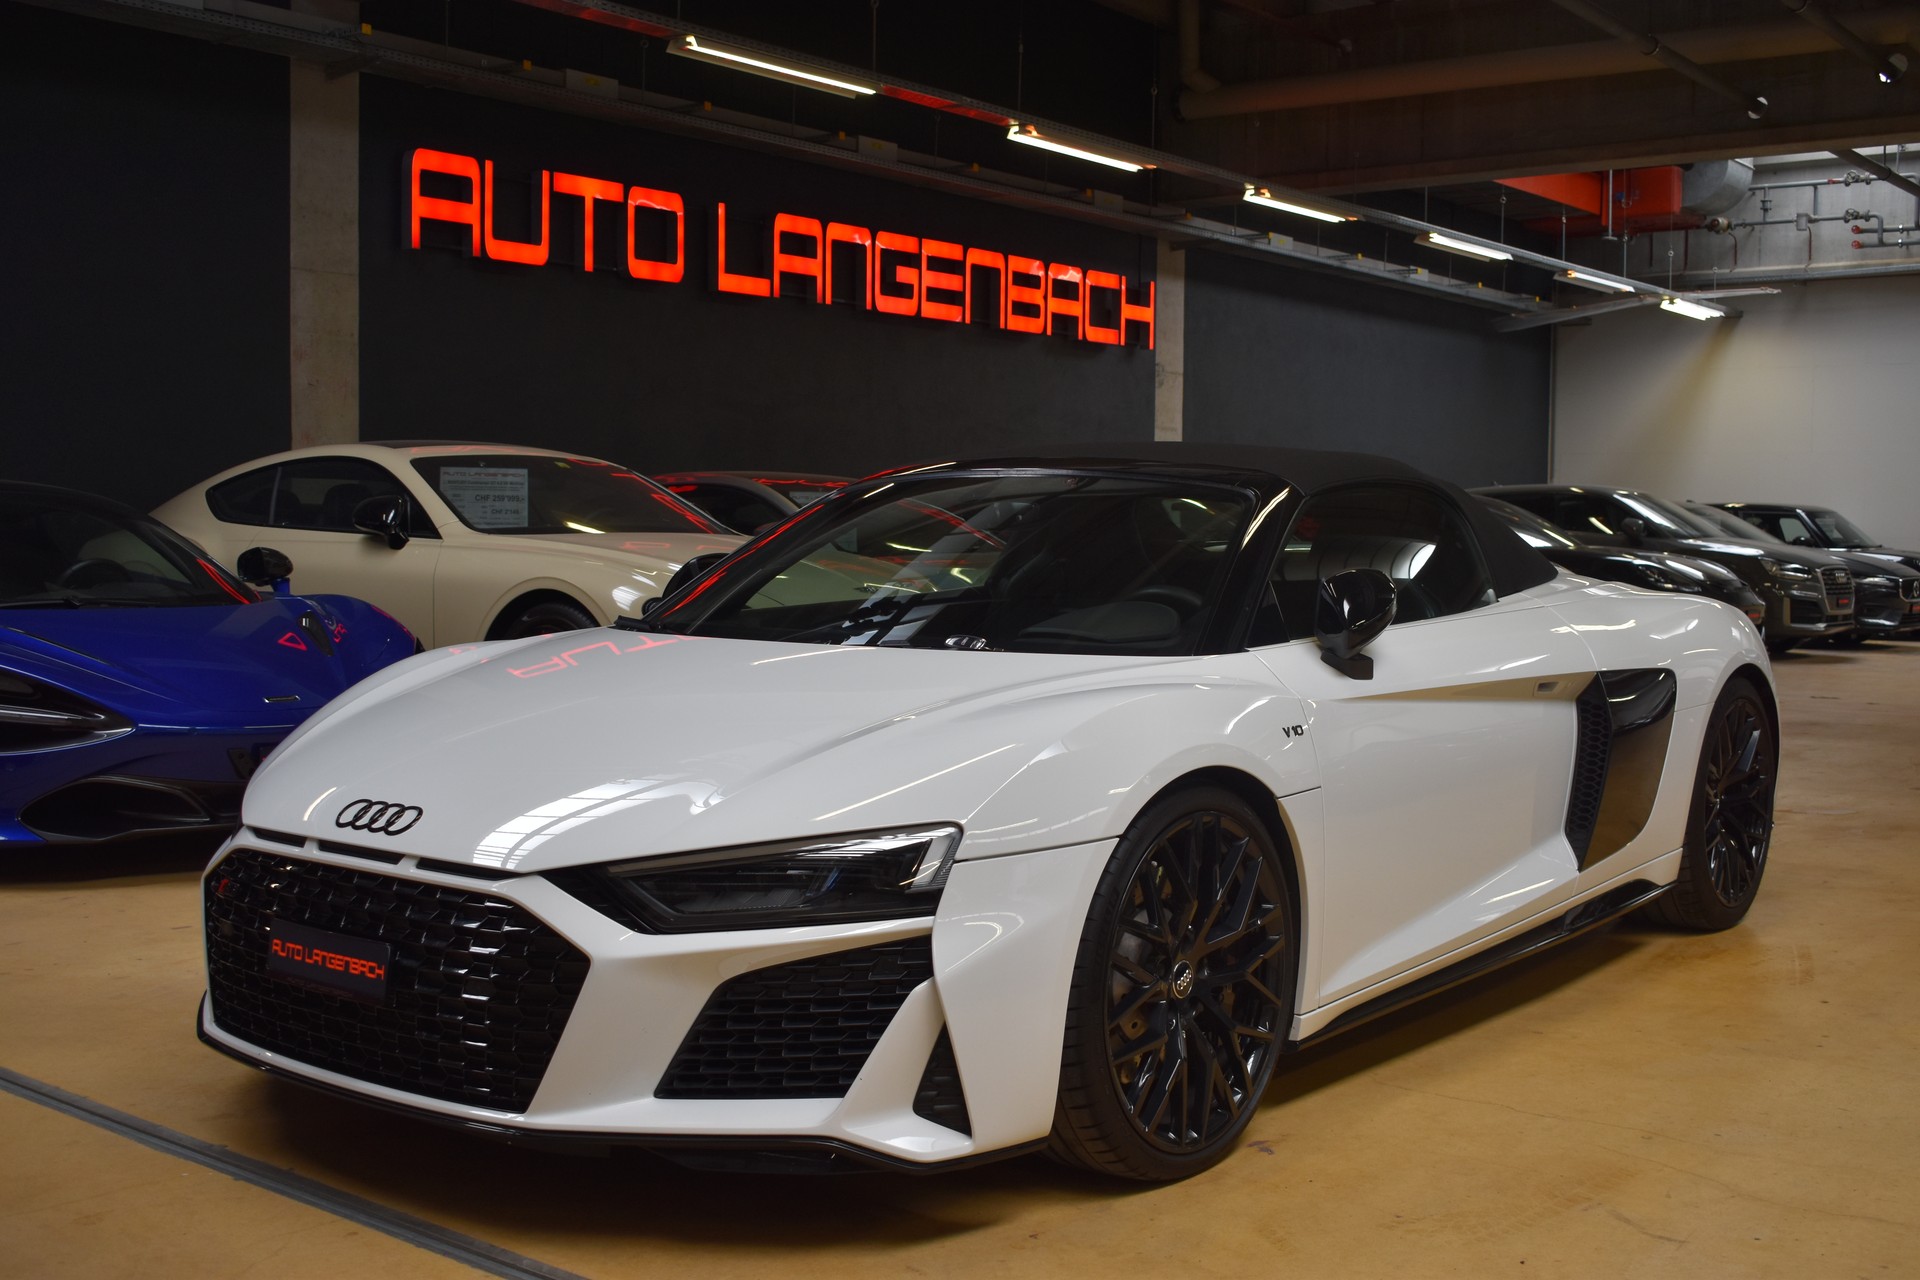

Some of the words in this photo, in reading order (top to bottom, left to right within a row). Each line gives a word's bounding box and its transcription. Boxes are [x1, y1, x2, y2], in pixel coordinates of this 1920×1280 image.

[411, 147, 685, 283] AUTO
[717, 202, 1155, 350] LANGENBACH
[1282, 725, 1304, 738] V10
[272, 939, 303, 961] AUTO
[305, 947, 385, 980] LANGENBACH
